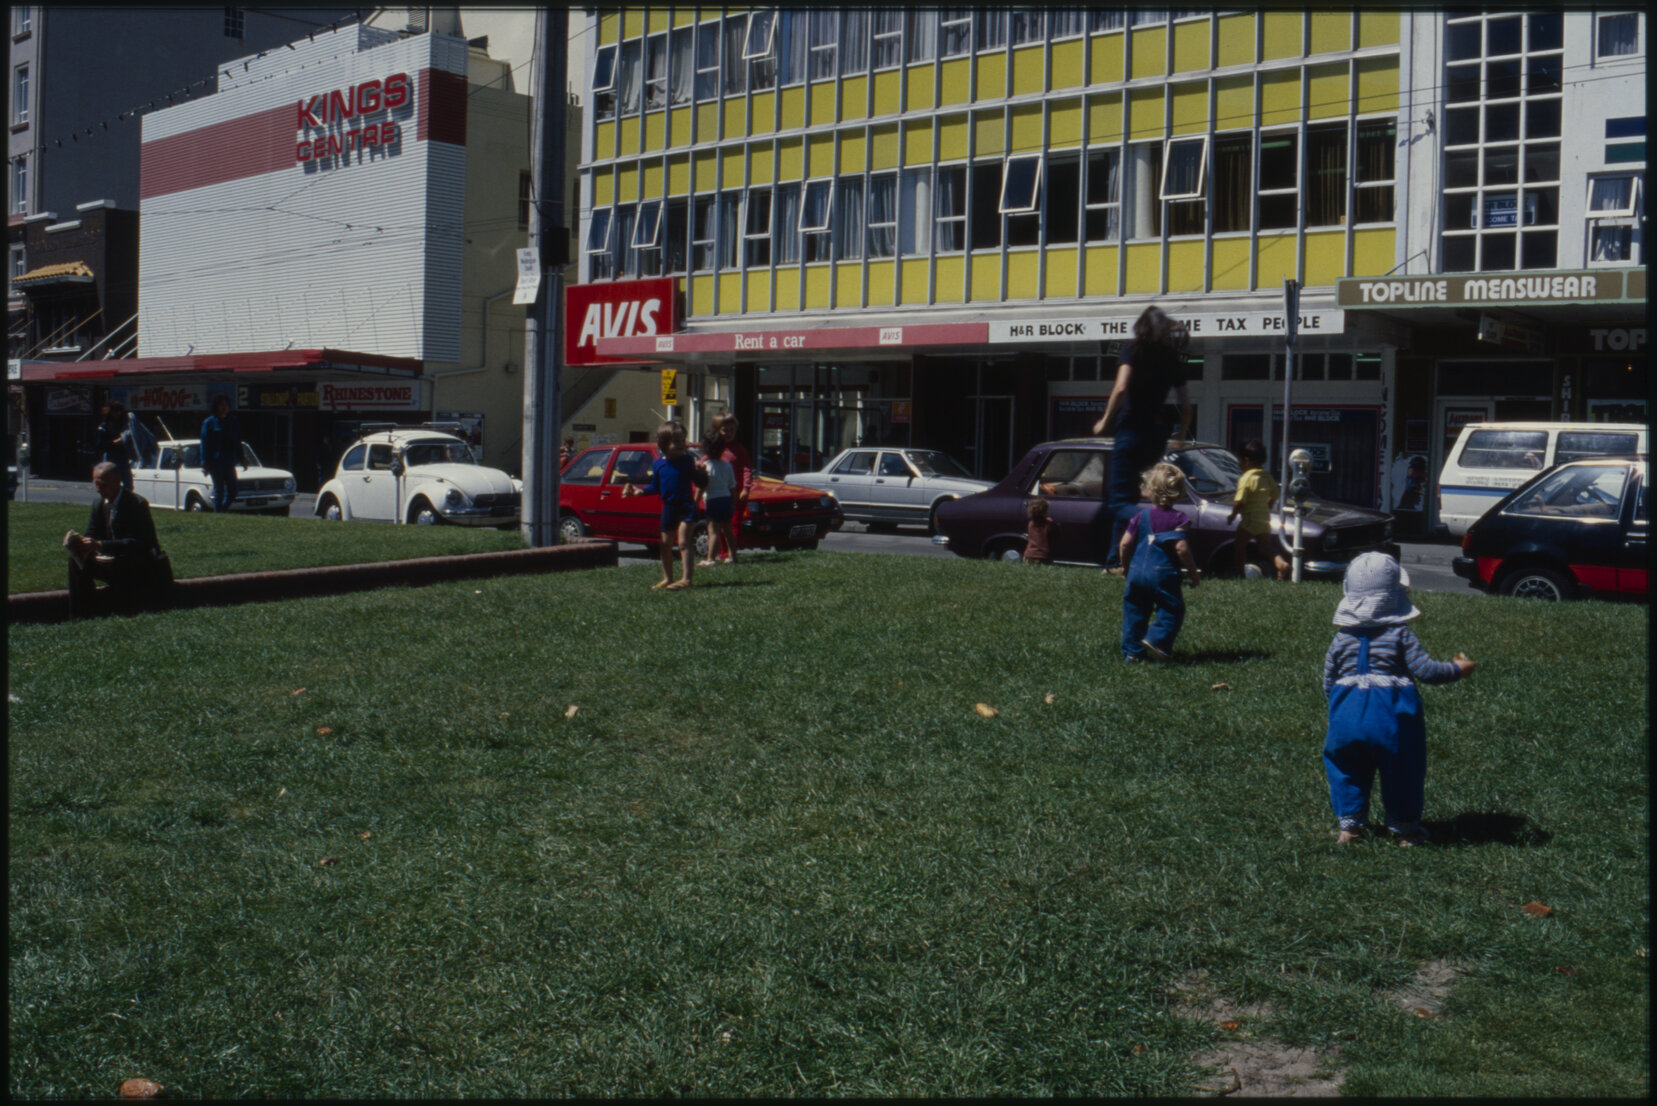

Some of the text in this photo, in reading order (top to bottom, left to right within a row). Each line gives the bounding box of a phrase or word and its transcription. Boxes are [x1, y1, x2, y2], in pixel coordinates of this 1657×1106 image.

[297, 72, 408, 130] KINGS
[296, 121, 396, 162] CENTRE
[1359, 276, 1597, 302] TOPLINE MENSWEAR
[577, 298, 661, 347] AVIS
[1010, 324, 1034, 336] H&R
[1039, 323, 1084, 335] BLOCK
[1101, 322, 1127, 334] THE
[1216, 318, 1247, 331] TAX
[657, 340, 672, 349] AVIS
[734, 334, 806, 350] Rent a car
[881, 330, 901, 341] AVIS
[323, 384, 412, 409] RHINESTONE
